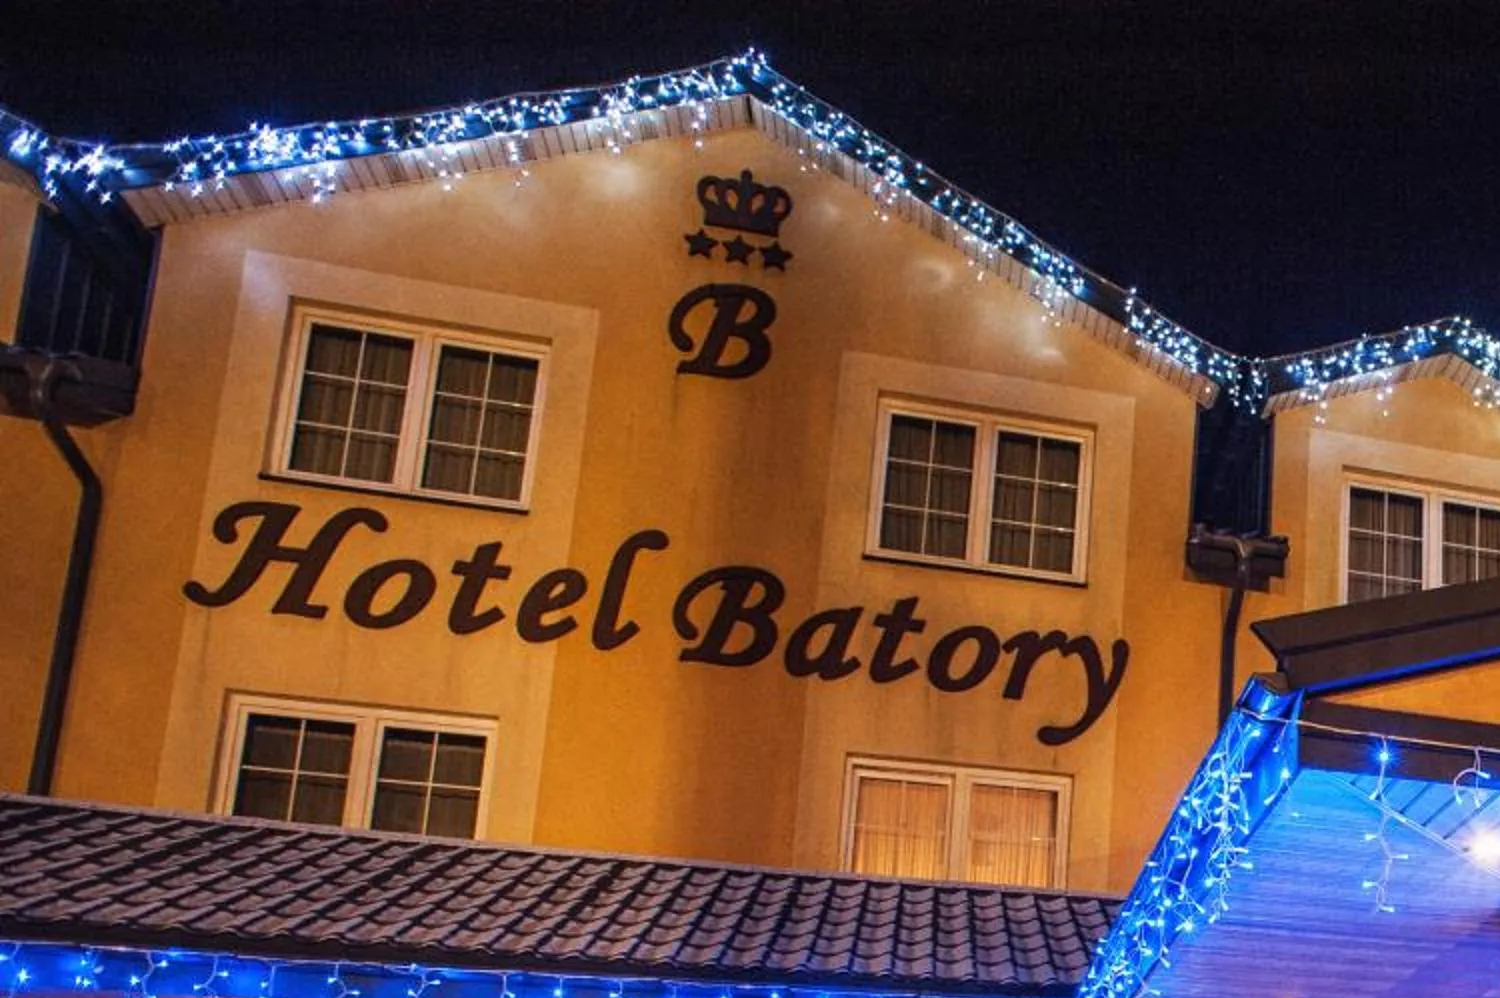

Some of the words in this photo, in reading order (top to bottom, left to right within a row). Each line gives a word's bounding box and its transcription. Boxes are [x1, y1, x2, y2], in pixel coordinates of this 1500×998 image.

[669, 283, 777, 379] B
[183, 501, 669, 650] Hotel
[673, 565, 1129, 746] Batory
